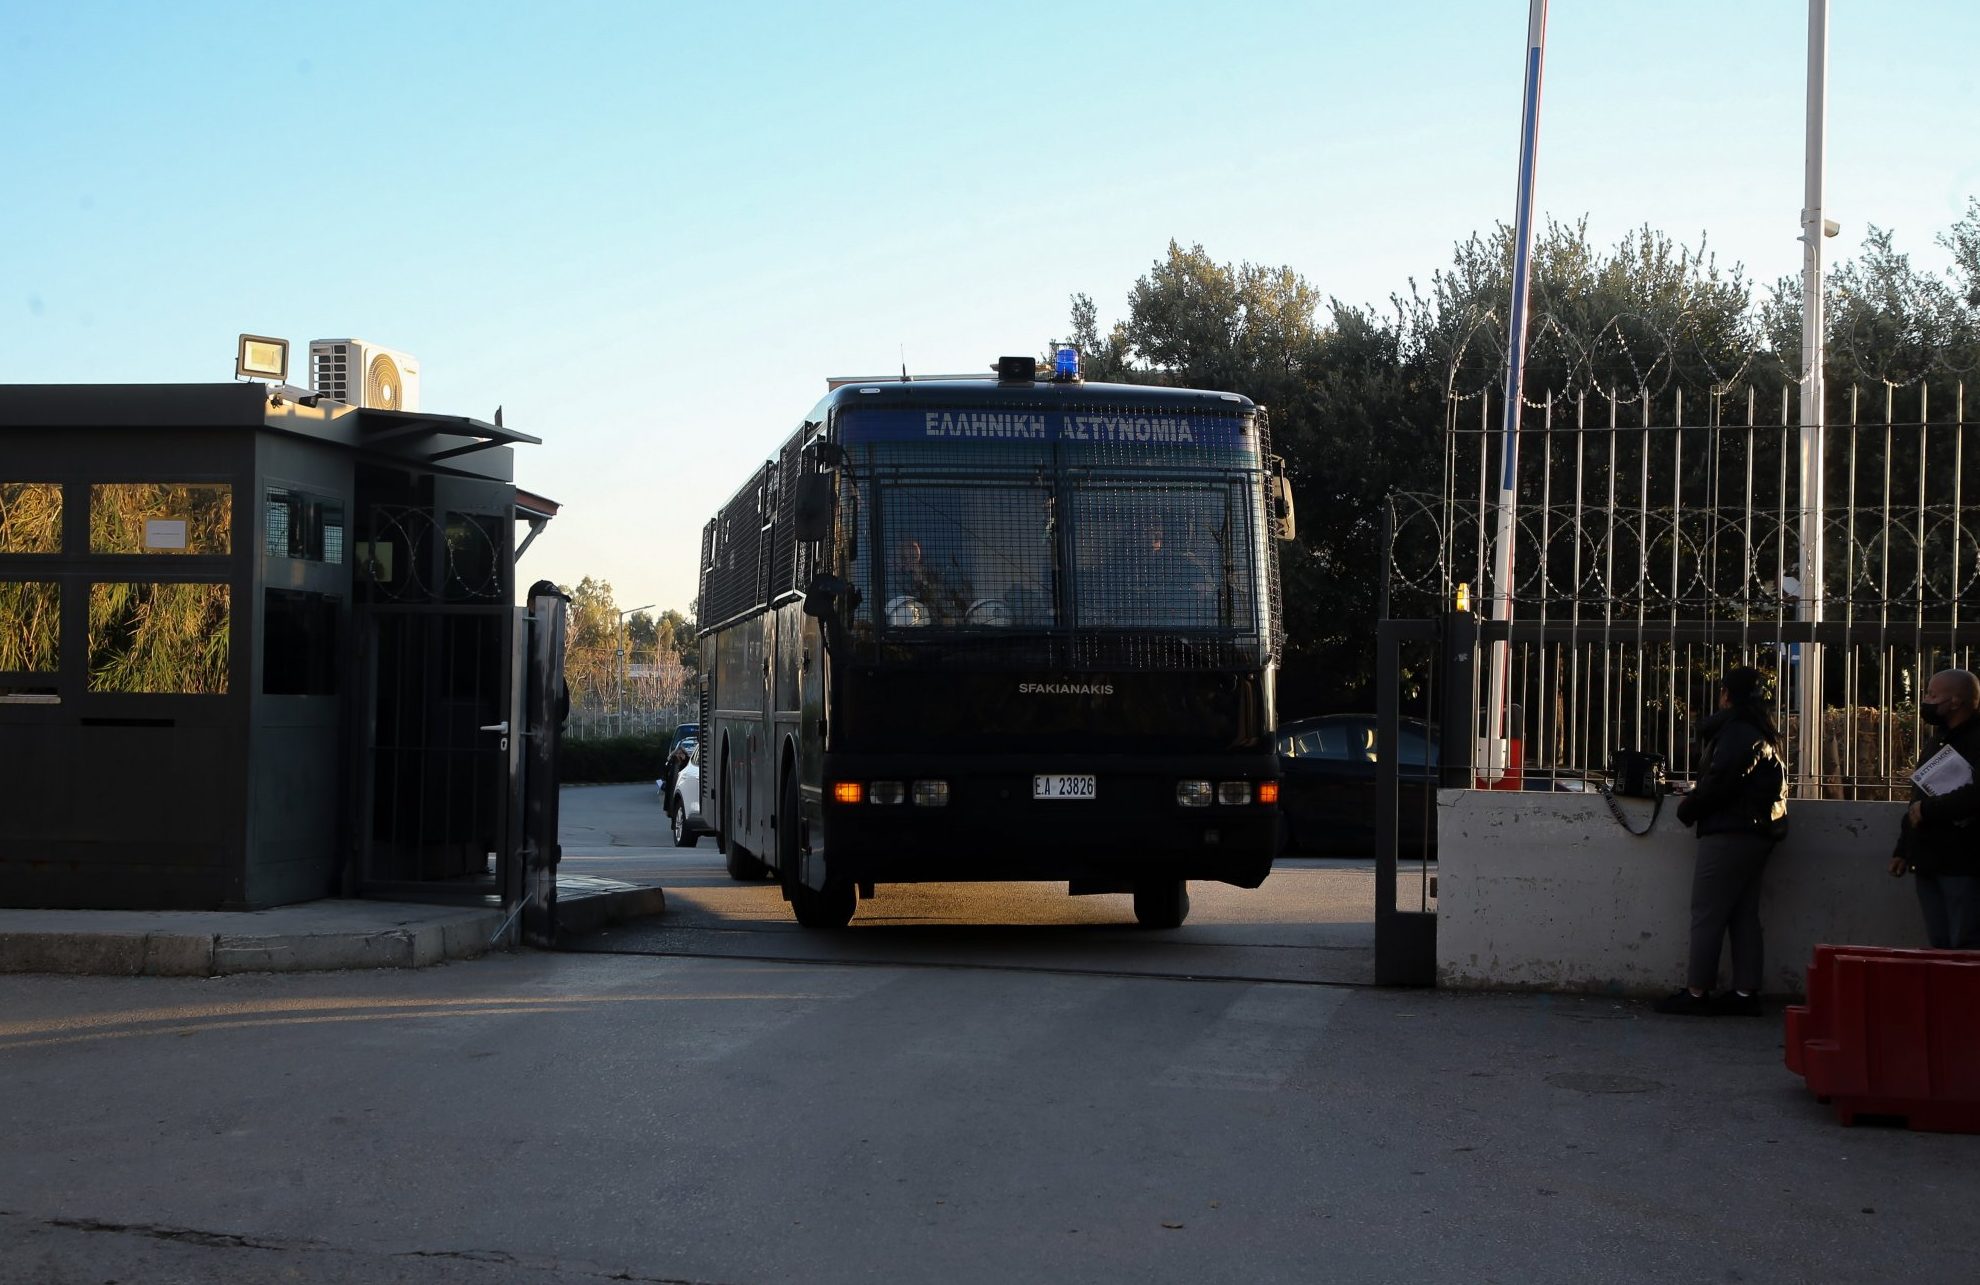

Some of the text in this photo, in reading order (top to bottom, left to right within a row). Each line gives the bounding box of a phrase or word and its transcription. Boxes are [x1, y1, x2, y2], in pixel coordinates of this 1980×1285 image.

[925, 412, 1194, 443] ΕΛΛΗΝΙΚΗ ΑΣΤΥΝΟΜΙΑ
[1018, 683, 1114, 695] SFAKIANAKIS
[1059, 777, 1093, 795] 23826
